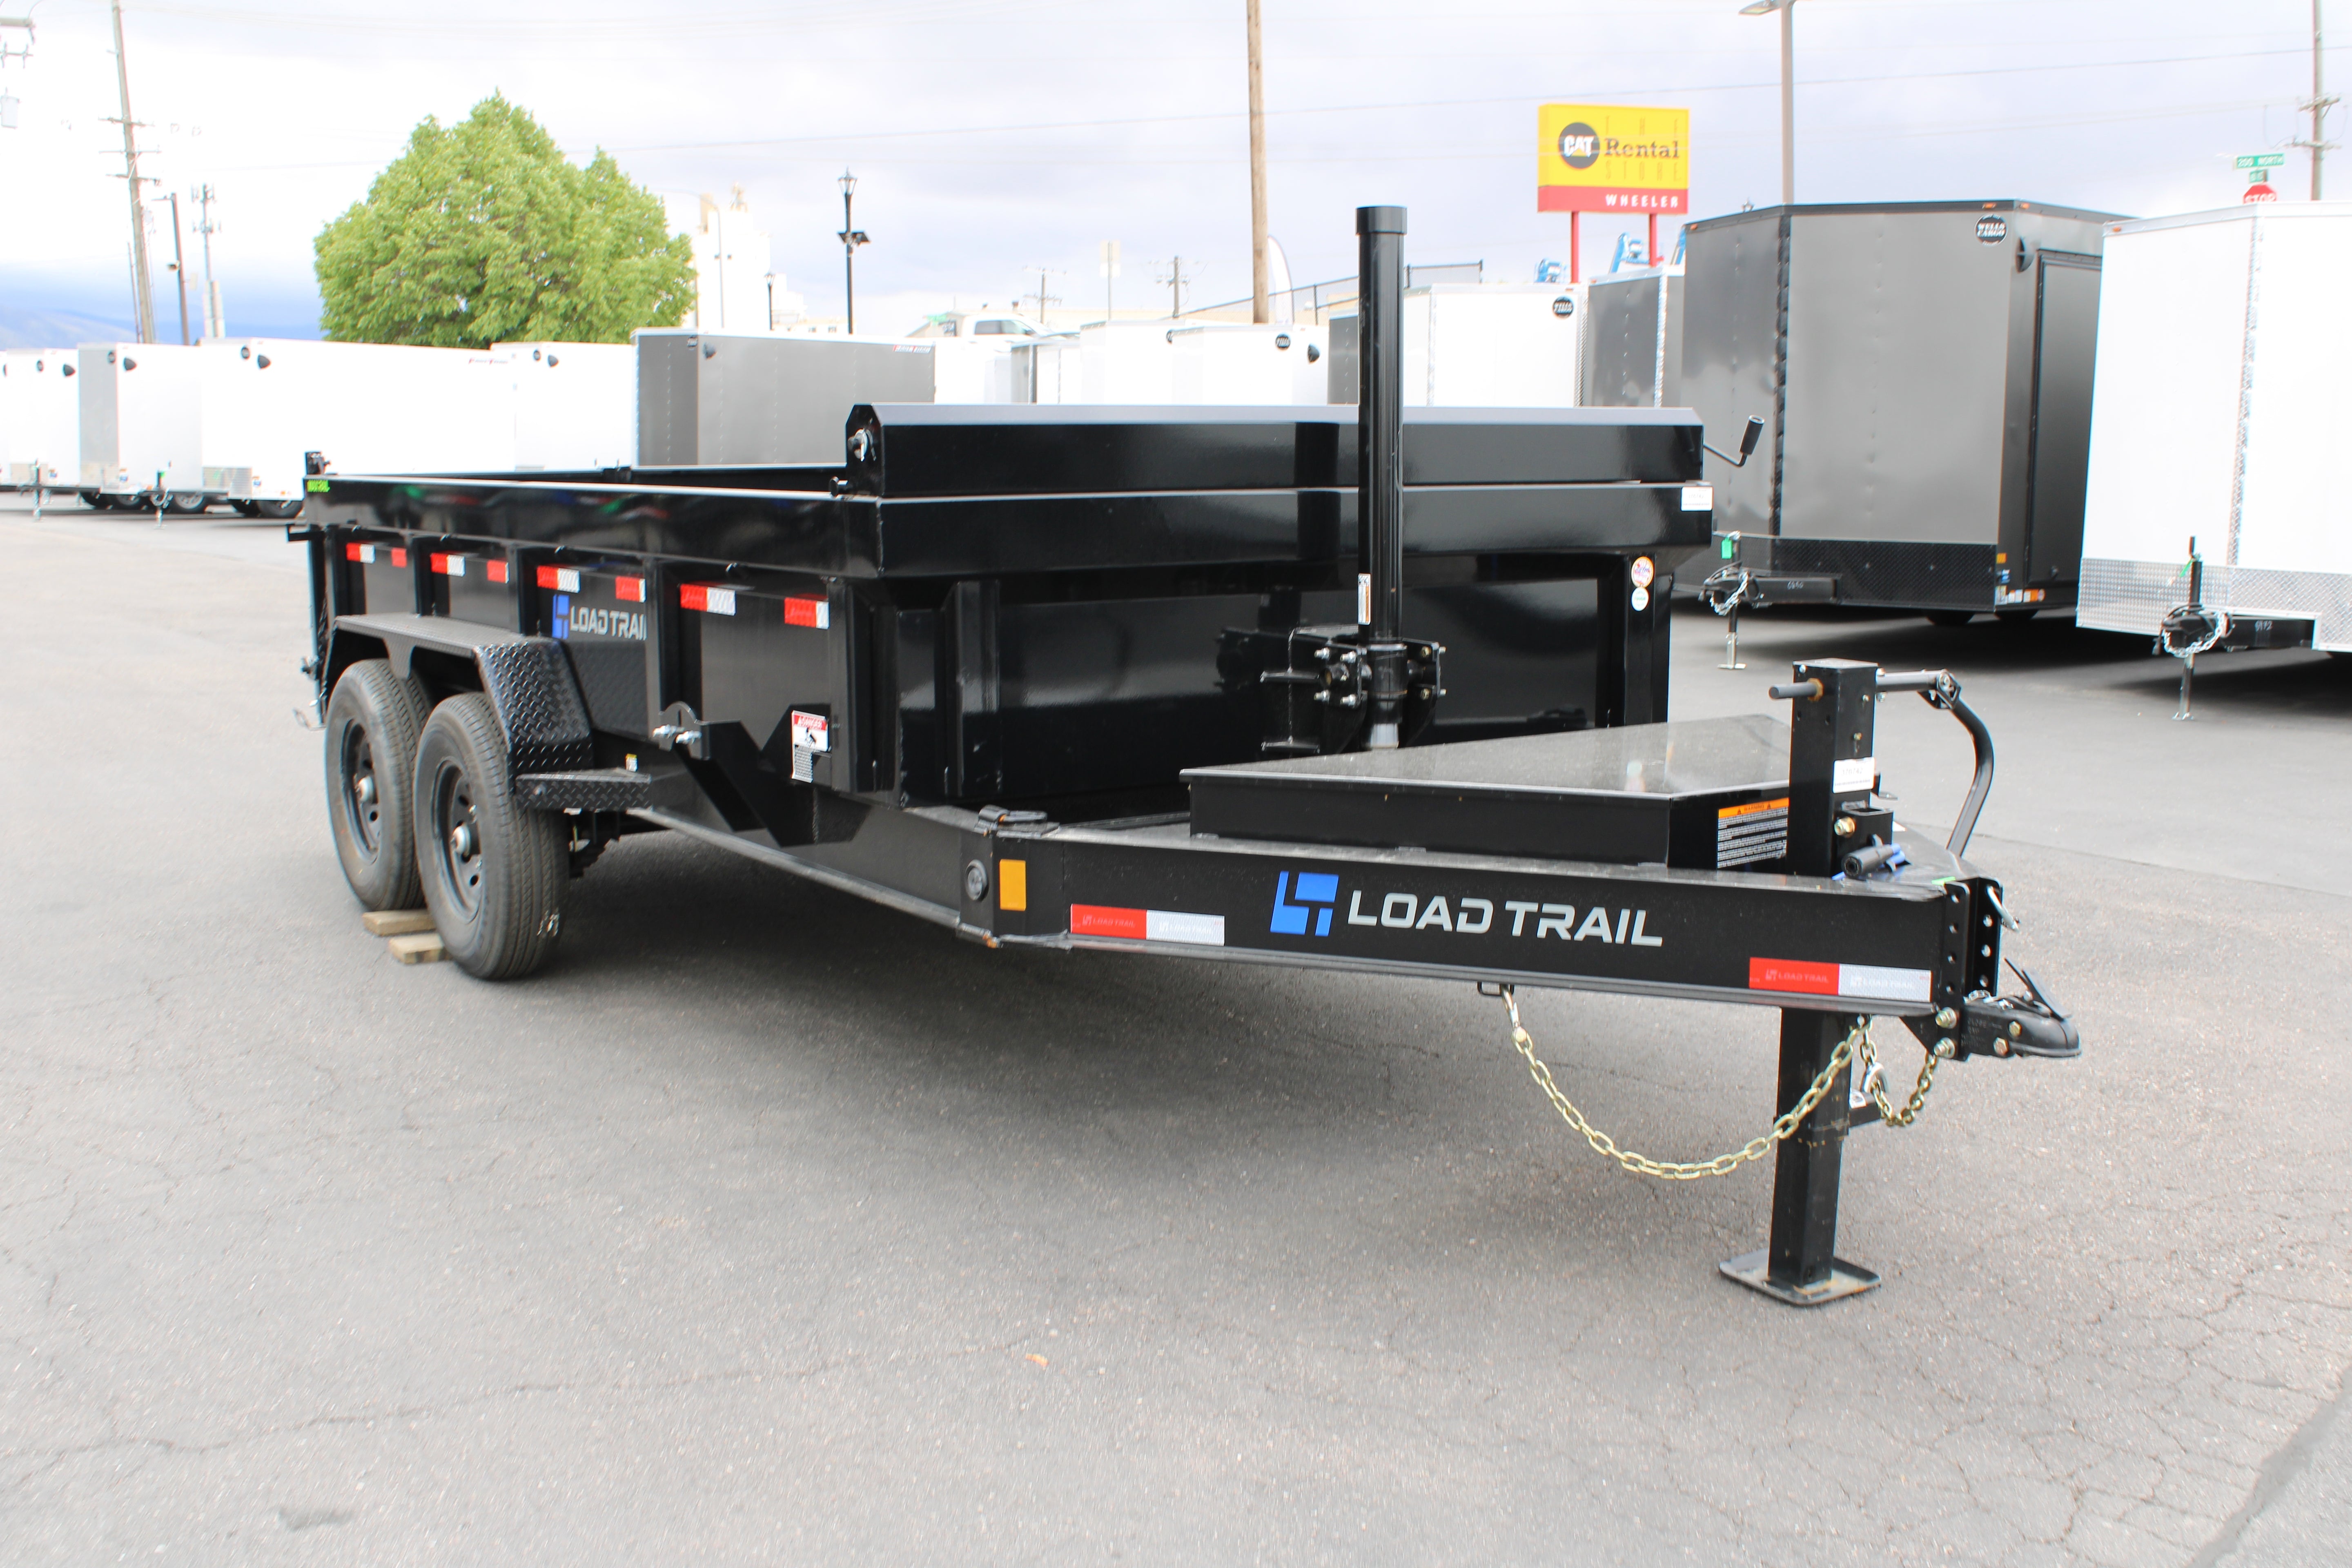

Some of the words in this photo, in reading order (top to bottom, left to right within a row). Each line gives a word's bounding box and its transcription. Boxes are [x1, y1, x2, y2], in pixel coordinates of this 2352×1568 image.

[1564, 134, 1595, 158] CAT
[1604, 138, 1680, 159] Rental
[1606, 194, 1679, 208] WHEELER
[570, 606, 609, 635] LOAD
[1093, 918, 1113, 926] LOAD
[1114, 919, 1136, 928] TRAIL
[1348, 890, 1494, 934] LOAD
[1505, 900, 1663, 947] TRAIL
[1804, 975, 1829, 983] TRAIL
